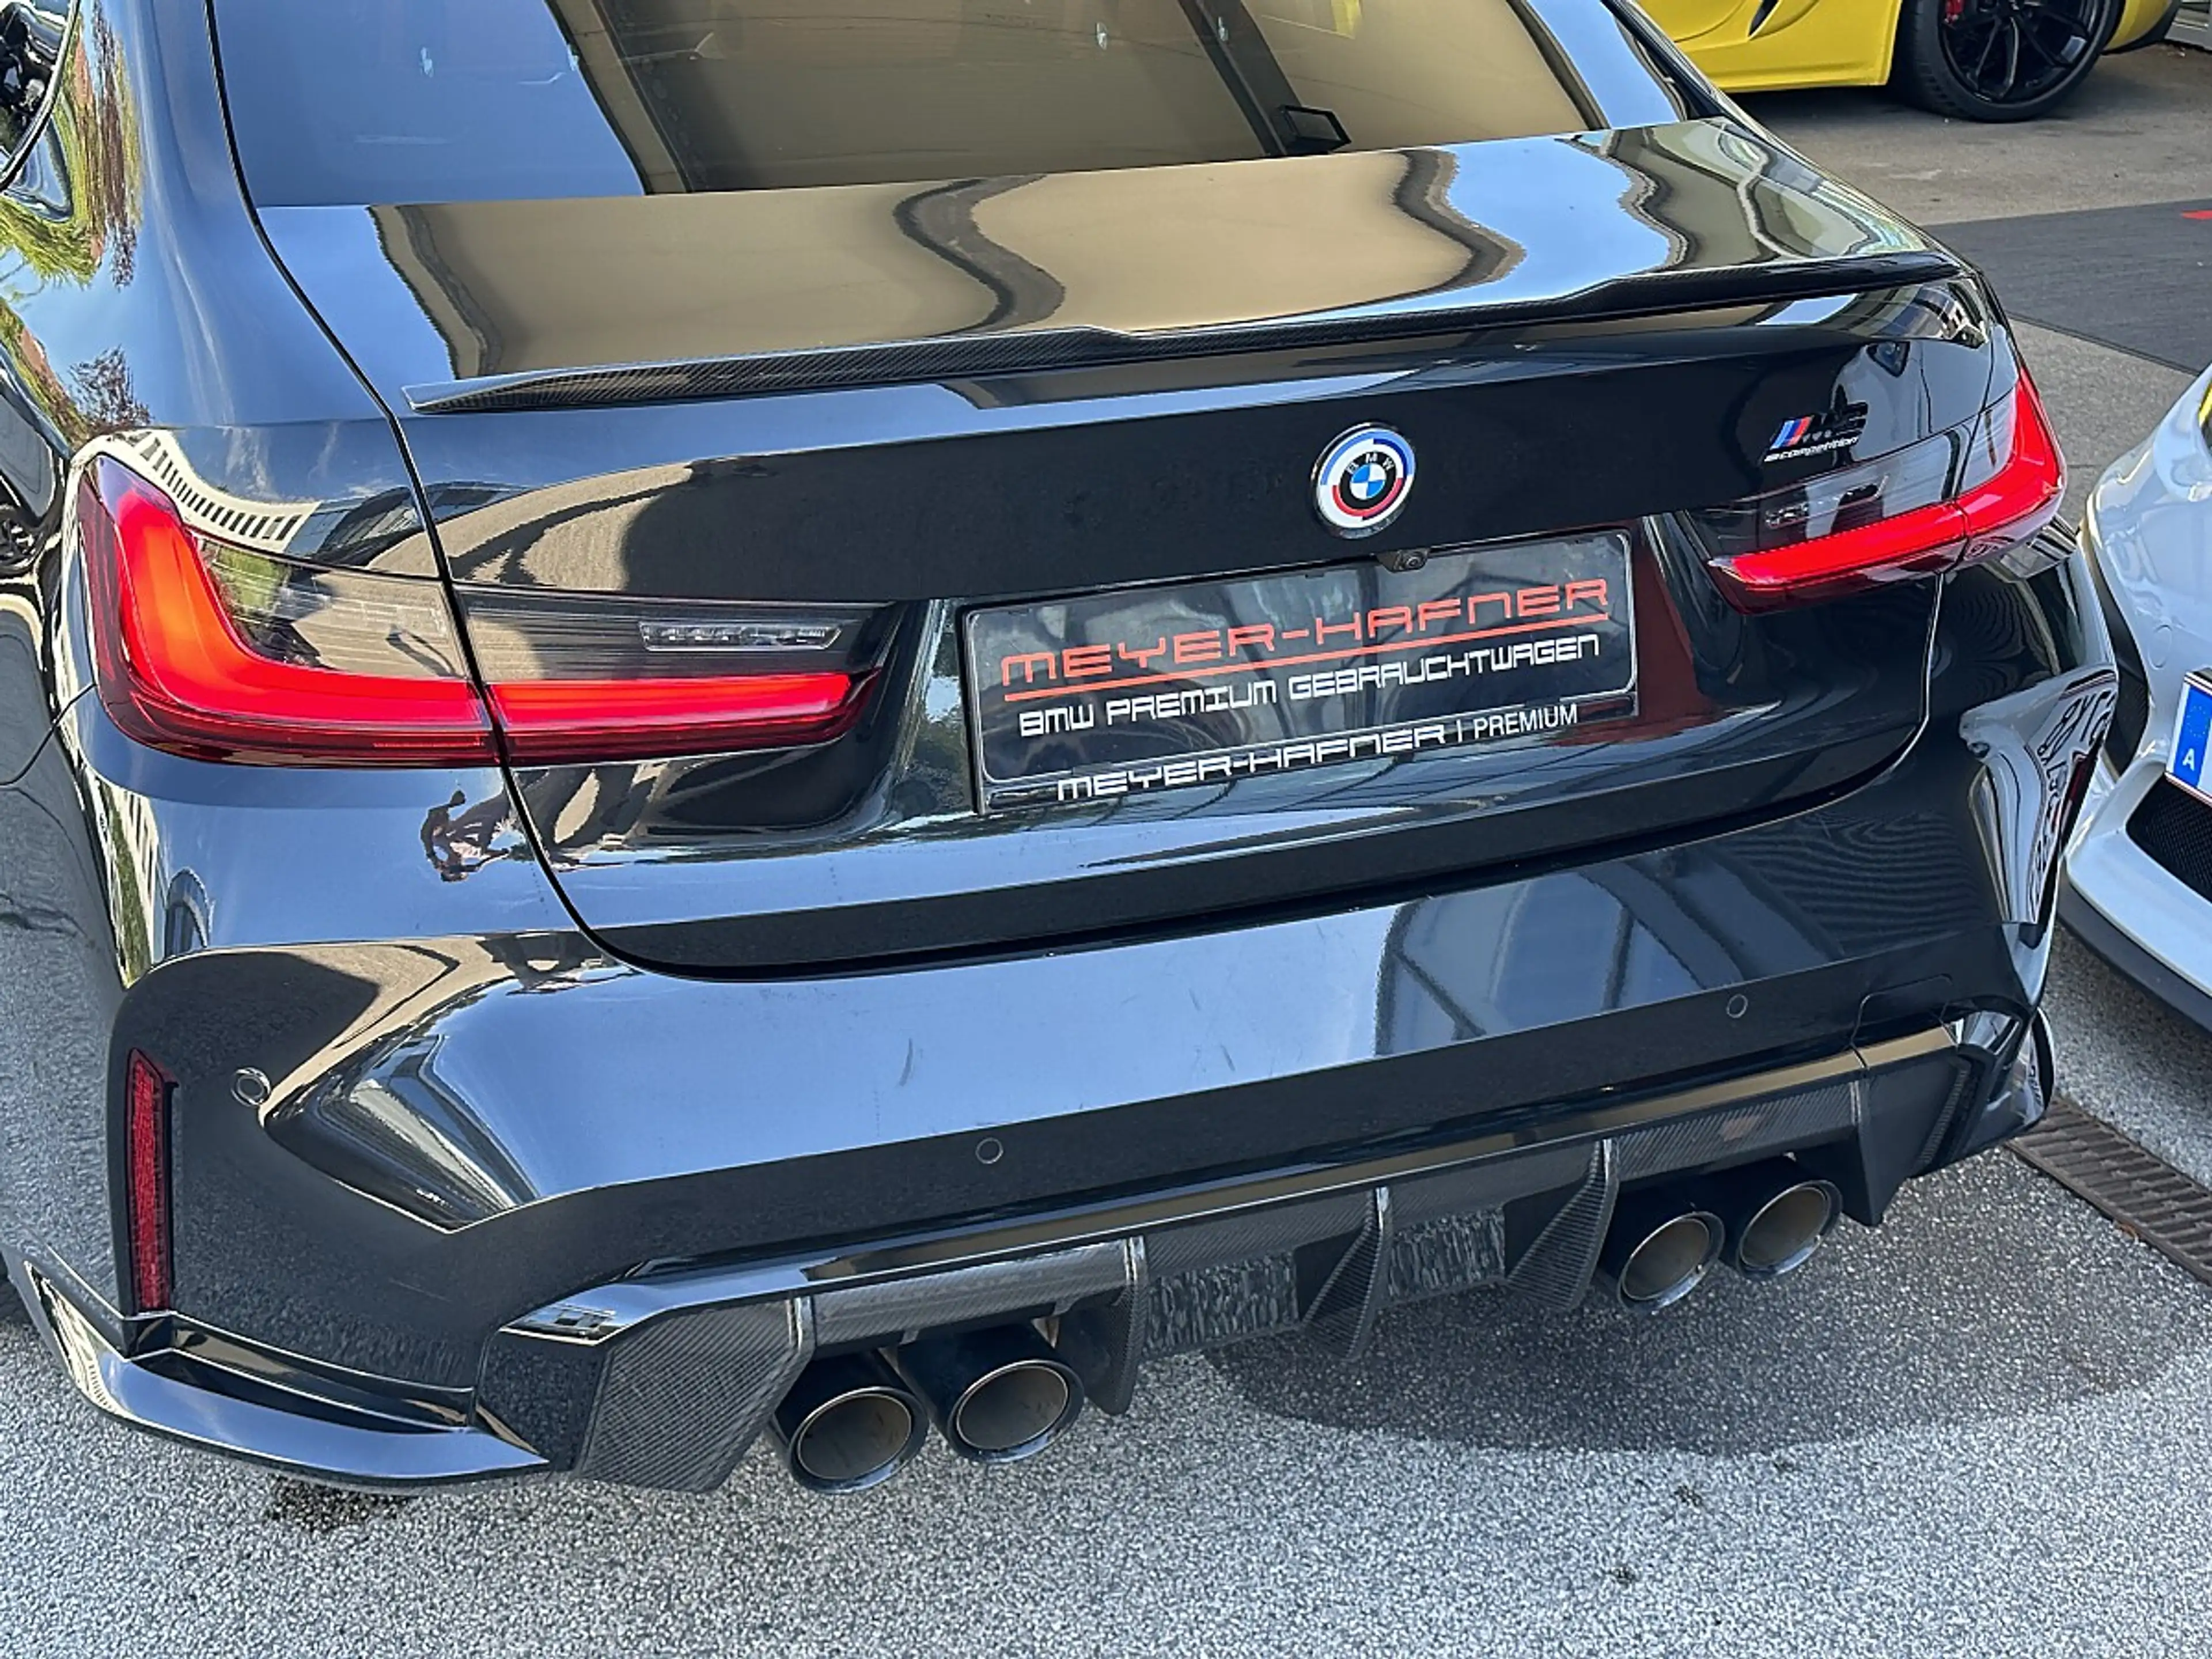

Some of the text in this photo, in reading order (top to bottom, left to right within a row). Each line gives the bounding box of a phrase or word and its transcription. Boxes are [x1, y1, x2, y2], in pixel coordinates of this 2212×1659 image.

[1345, 452, 1395, 475] BMW
[1001, 578, 1608, 685] MEYER-HAFNER
[1019, 633, 1600, 737] BMW PREMIUM GEBRAUCHTWAGEN
[1058, 703, 1578, 801] MEYER-HAFNER PREMIUM
[2182, 748, 2196, 771] A
